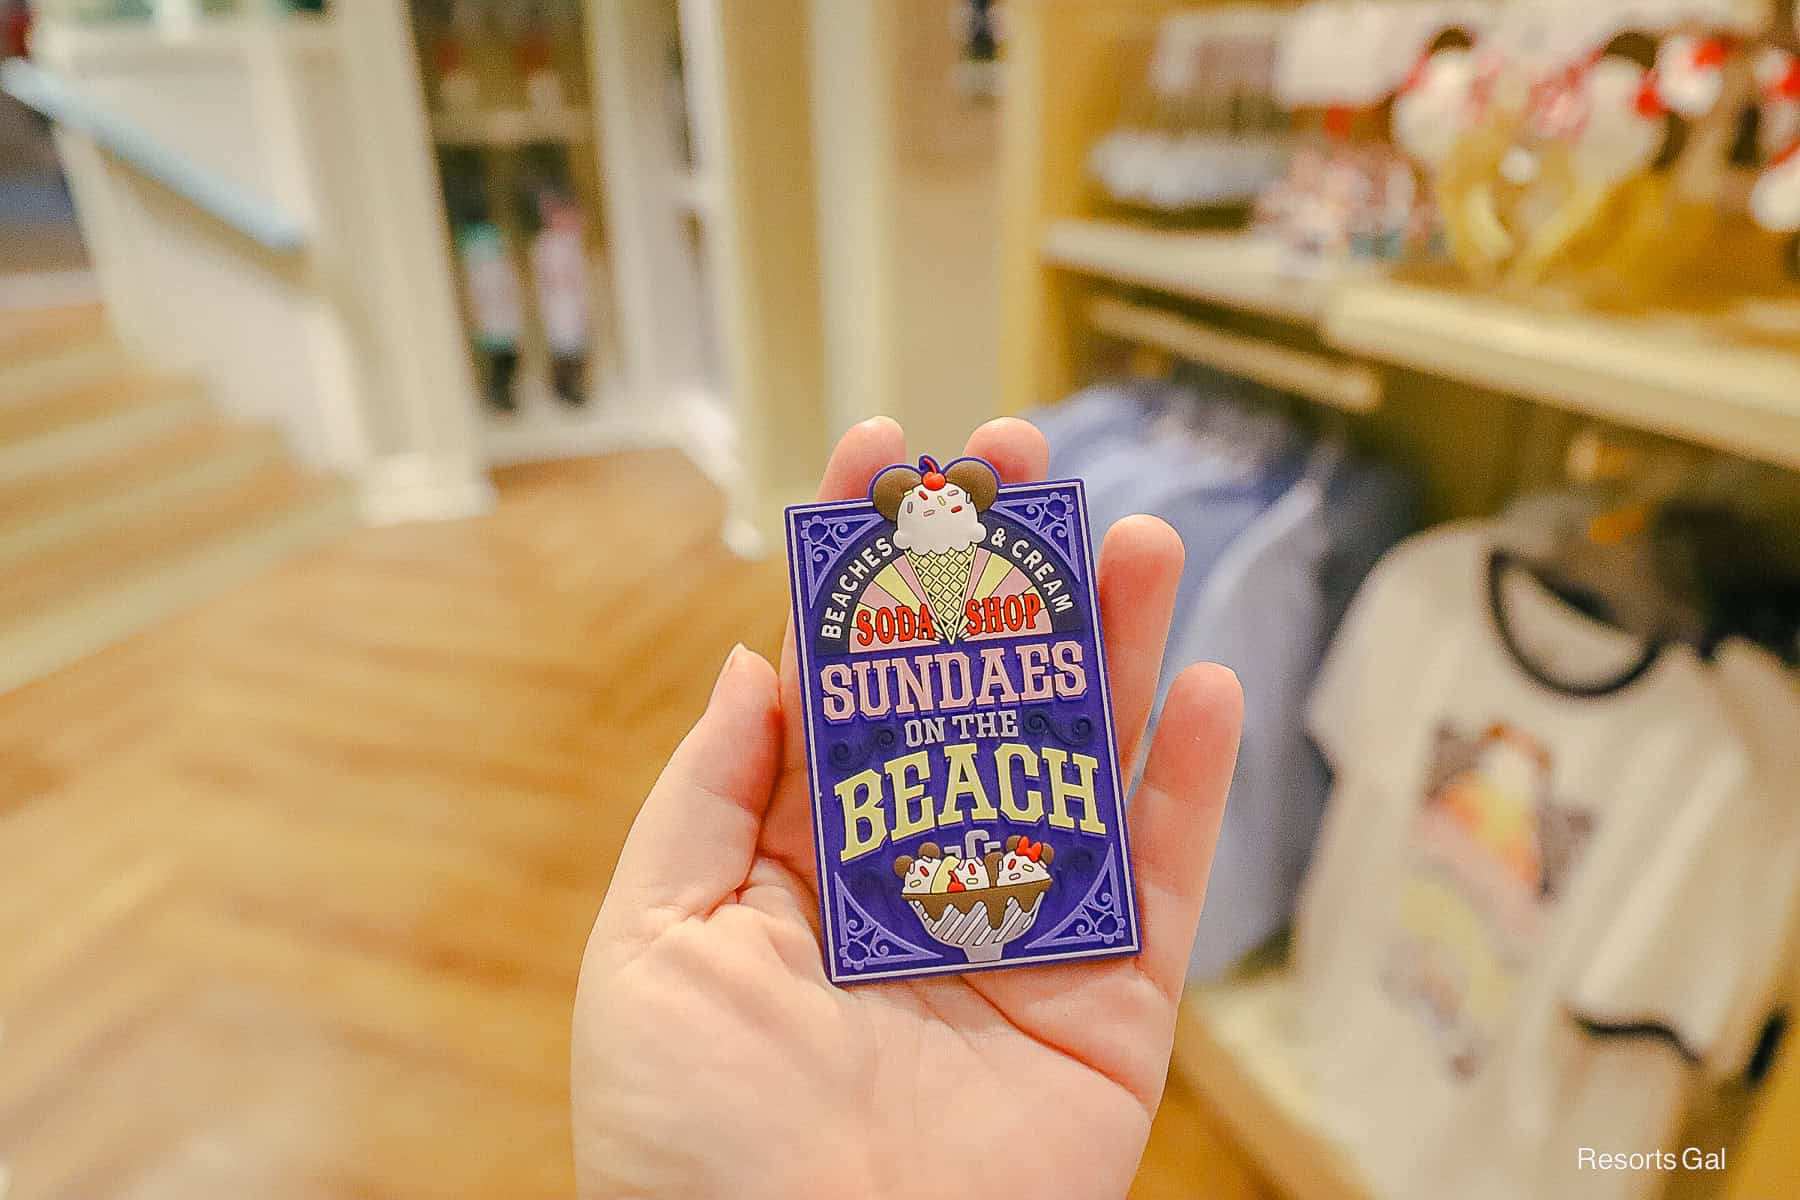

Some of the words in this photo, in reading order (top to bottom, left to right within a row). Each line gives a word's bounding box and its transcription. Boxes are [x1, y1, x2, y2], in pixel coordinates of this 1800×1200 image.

[821, 537, 893, 639] BEACHES
[991, 527, 1006, 548] &
[1012, 538, 1074, 613] CREAM
[856, 603, 937, 646] SODA
[965, 593, 1042, 635] SHOP
[820, 640, 1088, 721] SUNDAES
[904, 717, 946, 747] ON
[952, 711, 1019, 740] THE
[834, 743, 1107, 863] BEACH
